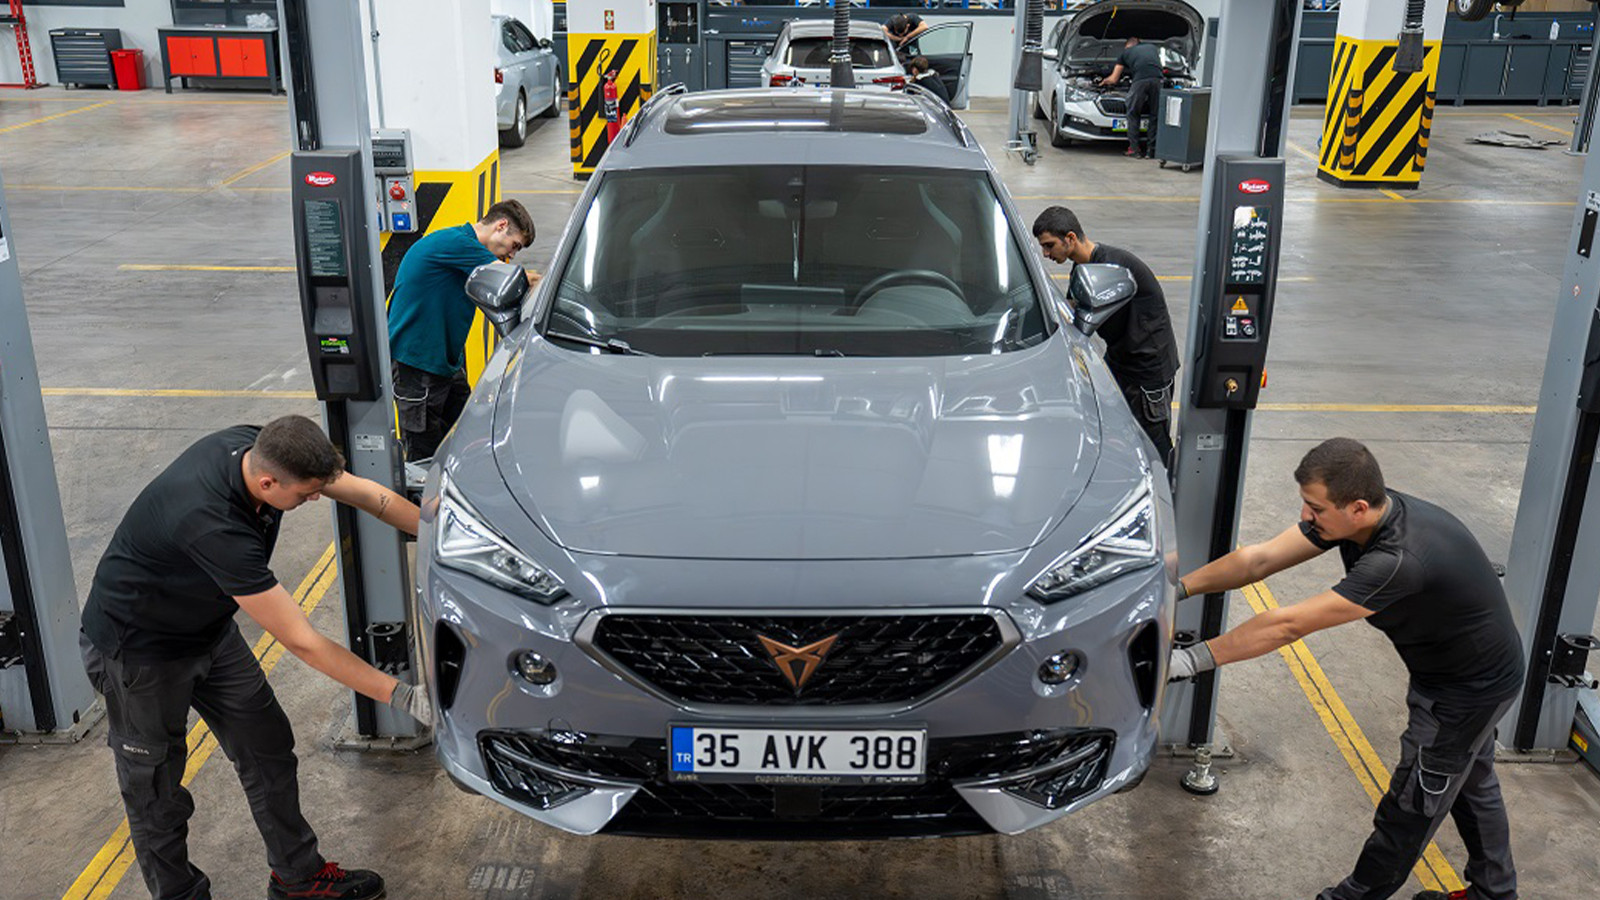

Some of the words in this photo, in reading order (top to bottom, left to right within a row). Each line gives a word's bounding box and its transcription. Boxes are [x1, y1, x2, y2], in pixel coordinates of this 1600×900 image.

[676, 752, 692, 763] TR
[696, 733, 740, 768] 35
[761, 735, 828, 769] AVK
[849, 736, 916, 769] 388
